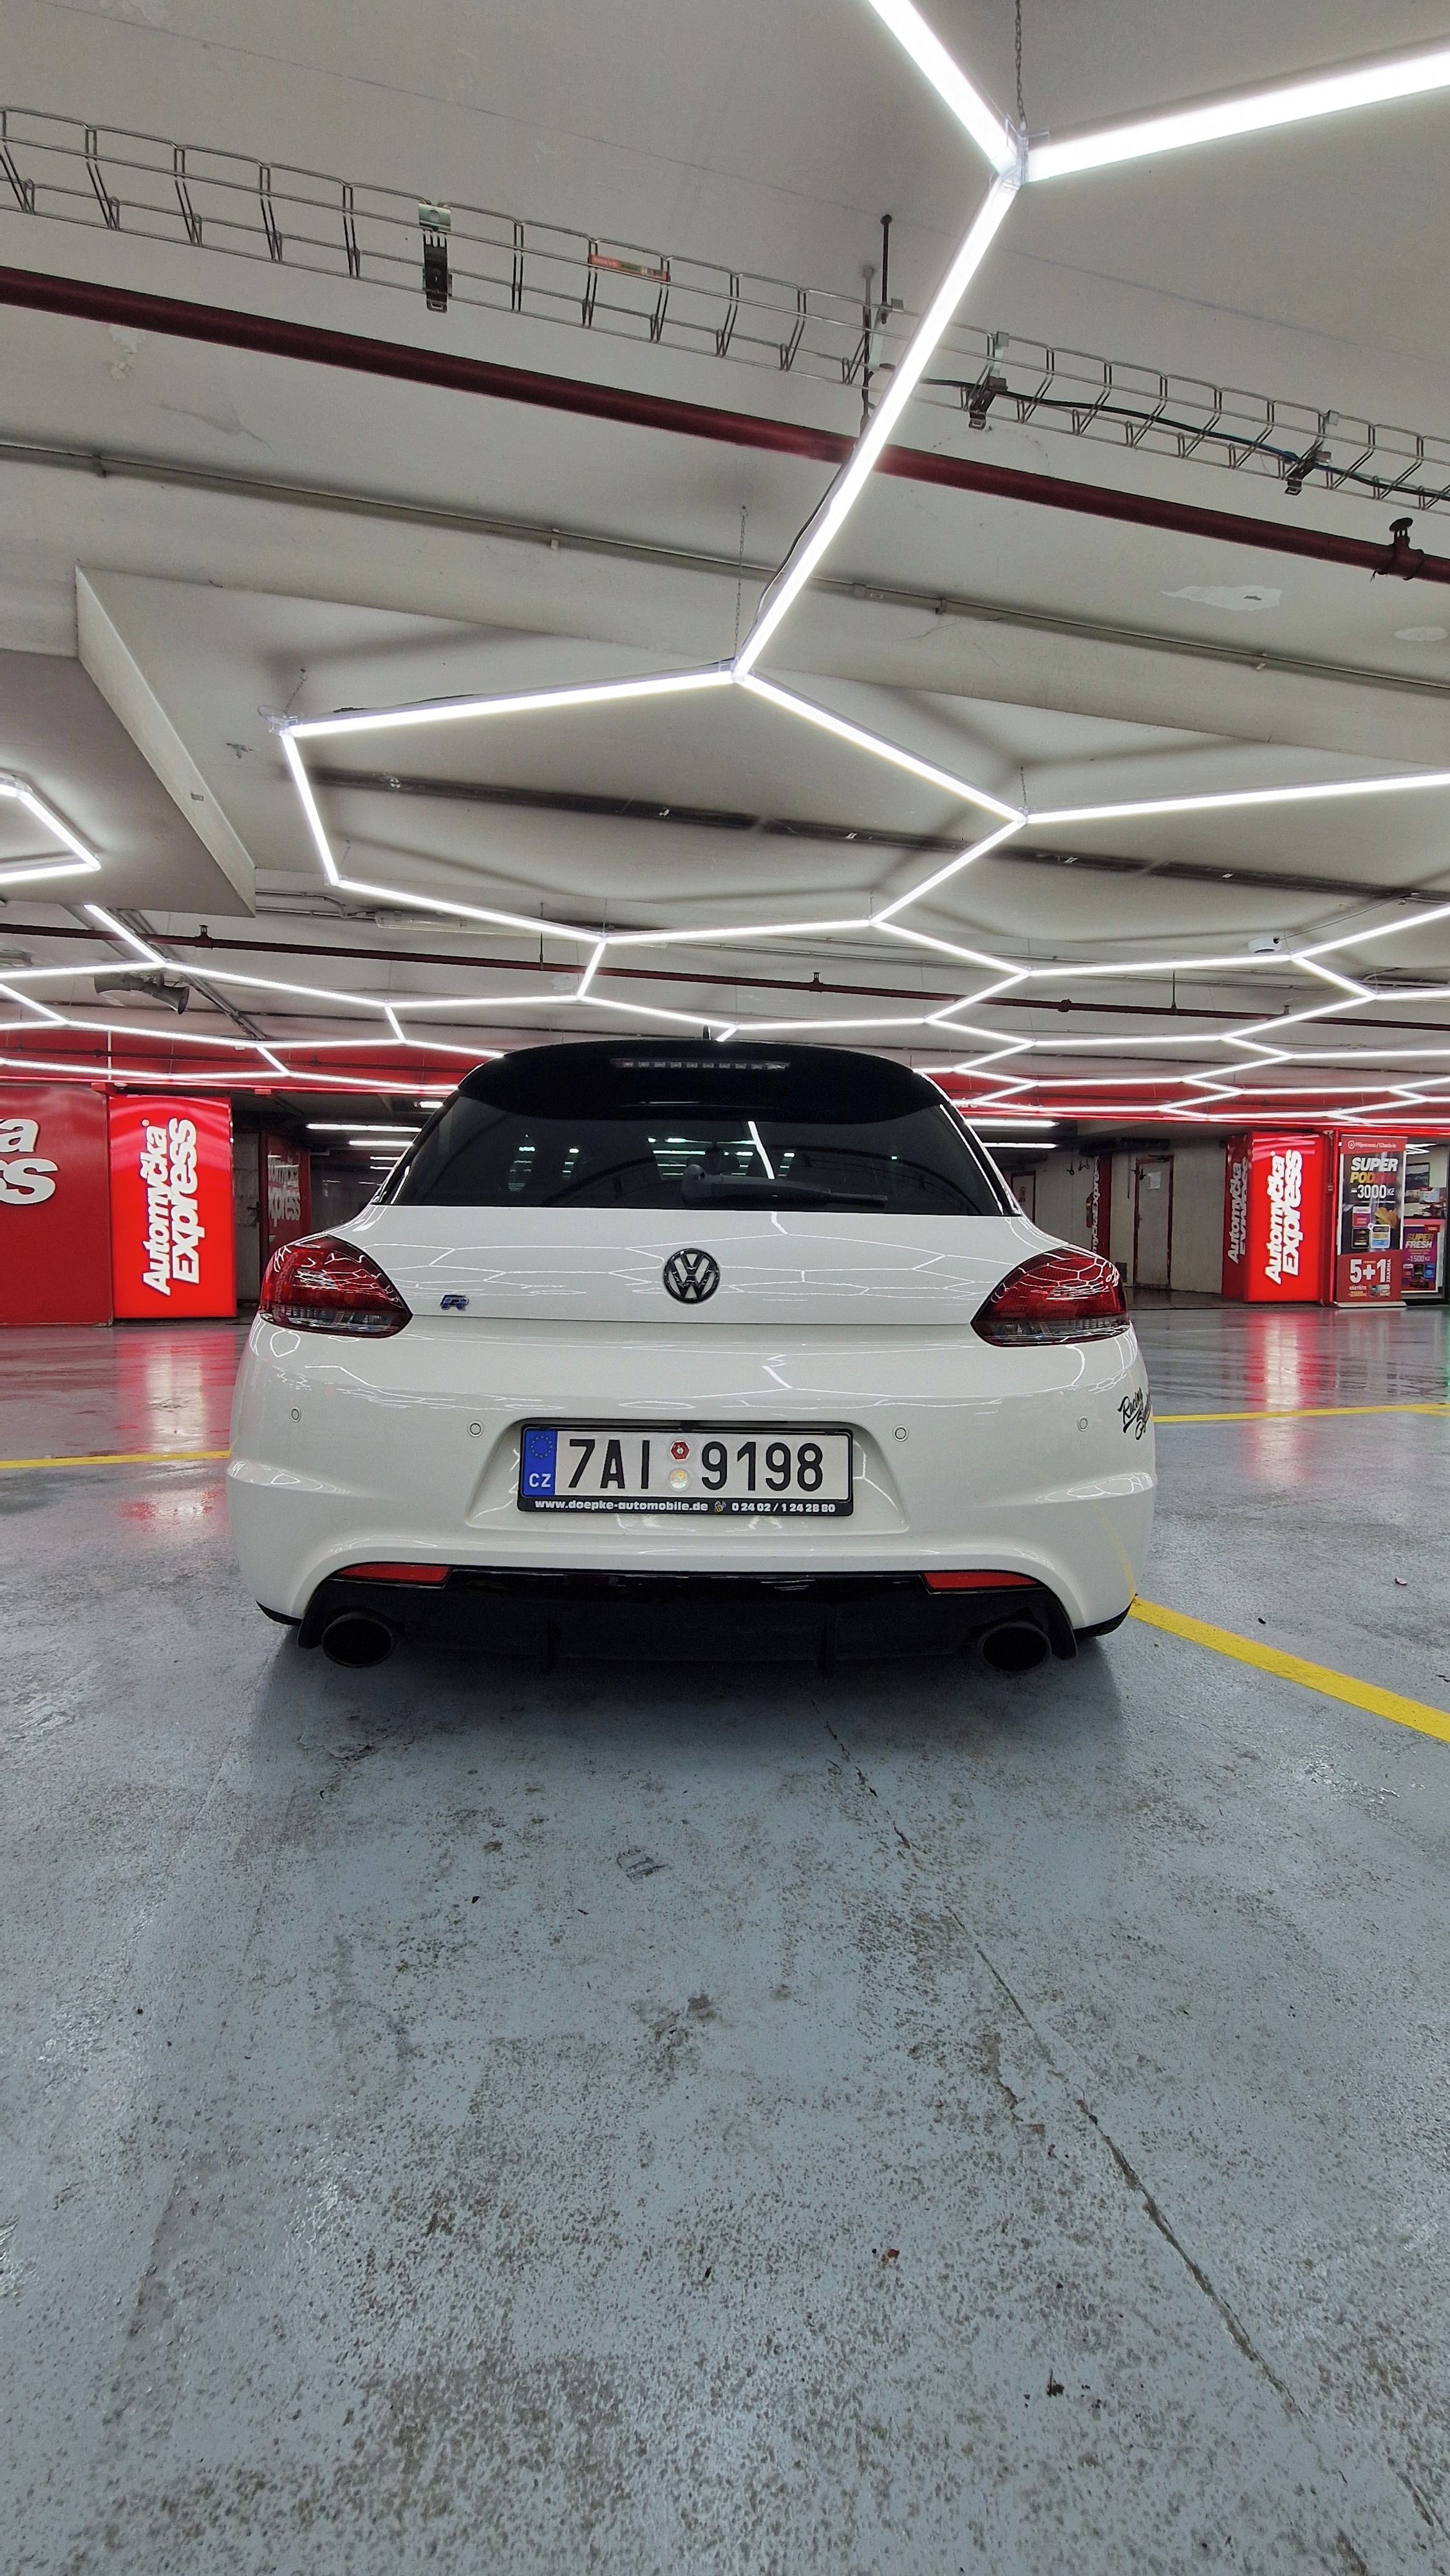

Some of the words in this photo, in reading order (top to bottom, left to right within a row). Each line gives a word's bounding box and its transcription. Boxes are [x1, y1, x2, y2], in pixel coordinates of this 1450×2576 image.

[1351, 1157, 1398, 1171] SUPER
[140, 1126, 171, 1296] Automyčka
[169, 1117, 205, 1283] Express
[1228, 1162, 1241, 1264] Automyčka
[1282, 1149, 1304, 1276] Express
[1351, 1184, 1387, 1198] -3000
[1265, 1155, 1285, 1285] Automyčka
[1350, 1259, 1386, 1283] 5+1
[529, 1473, 551, 1488] CZ
[702, 1441, 824, 1492] 9198
[534, 1500, 708, 1511] www.doepke-automobile.de
